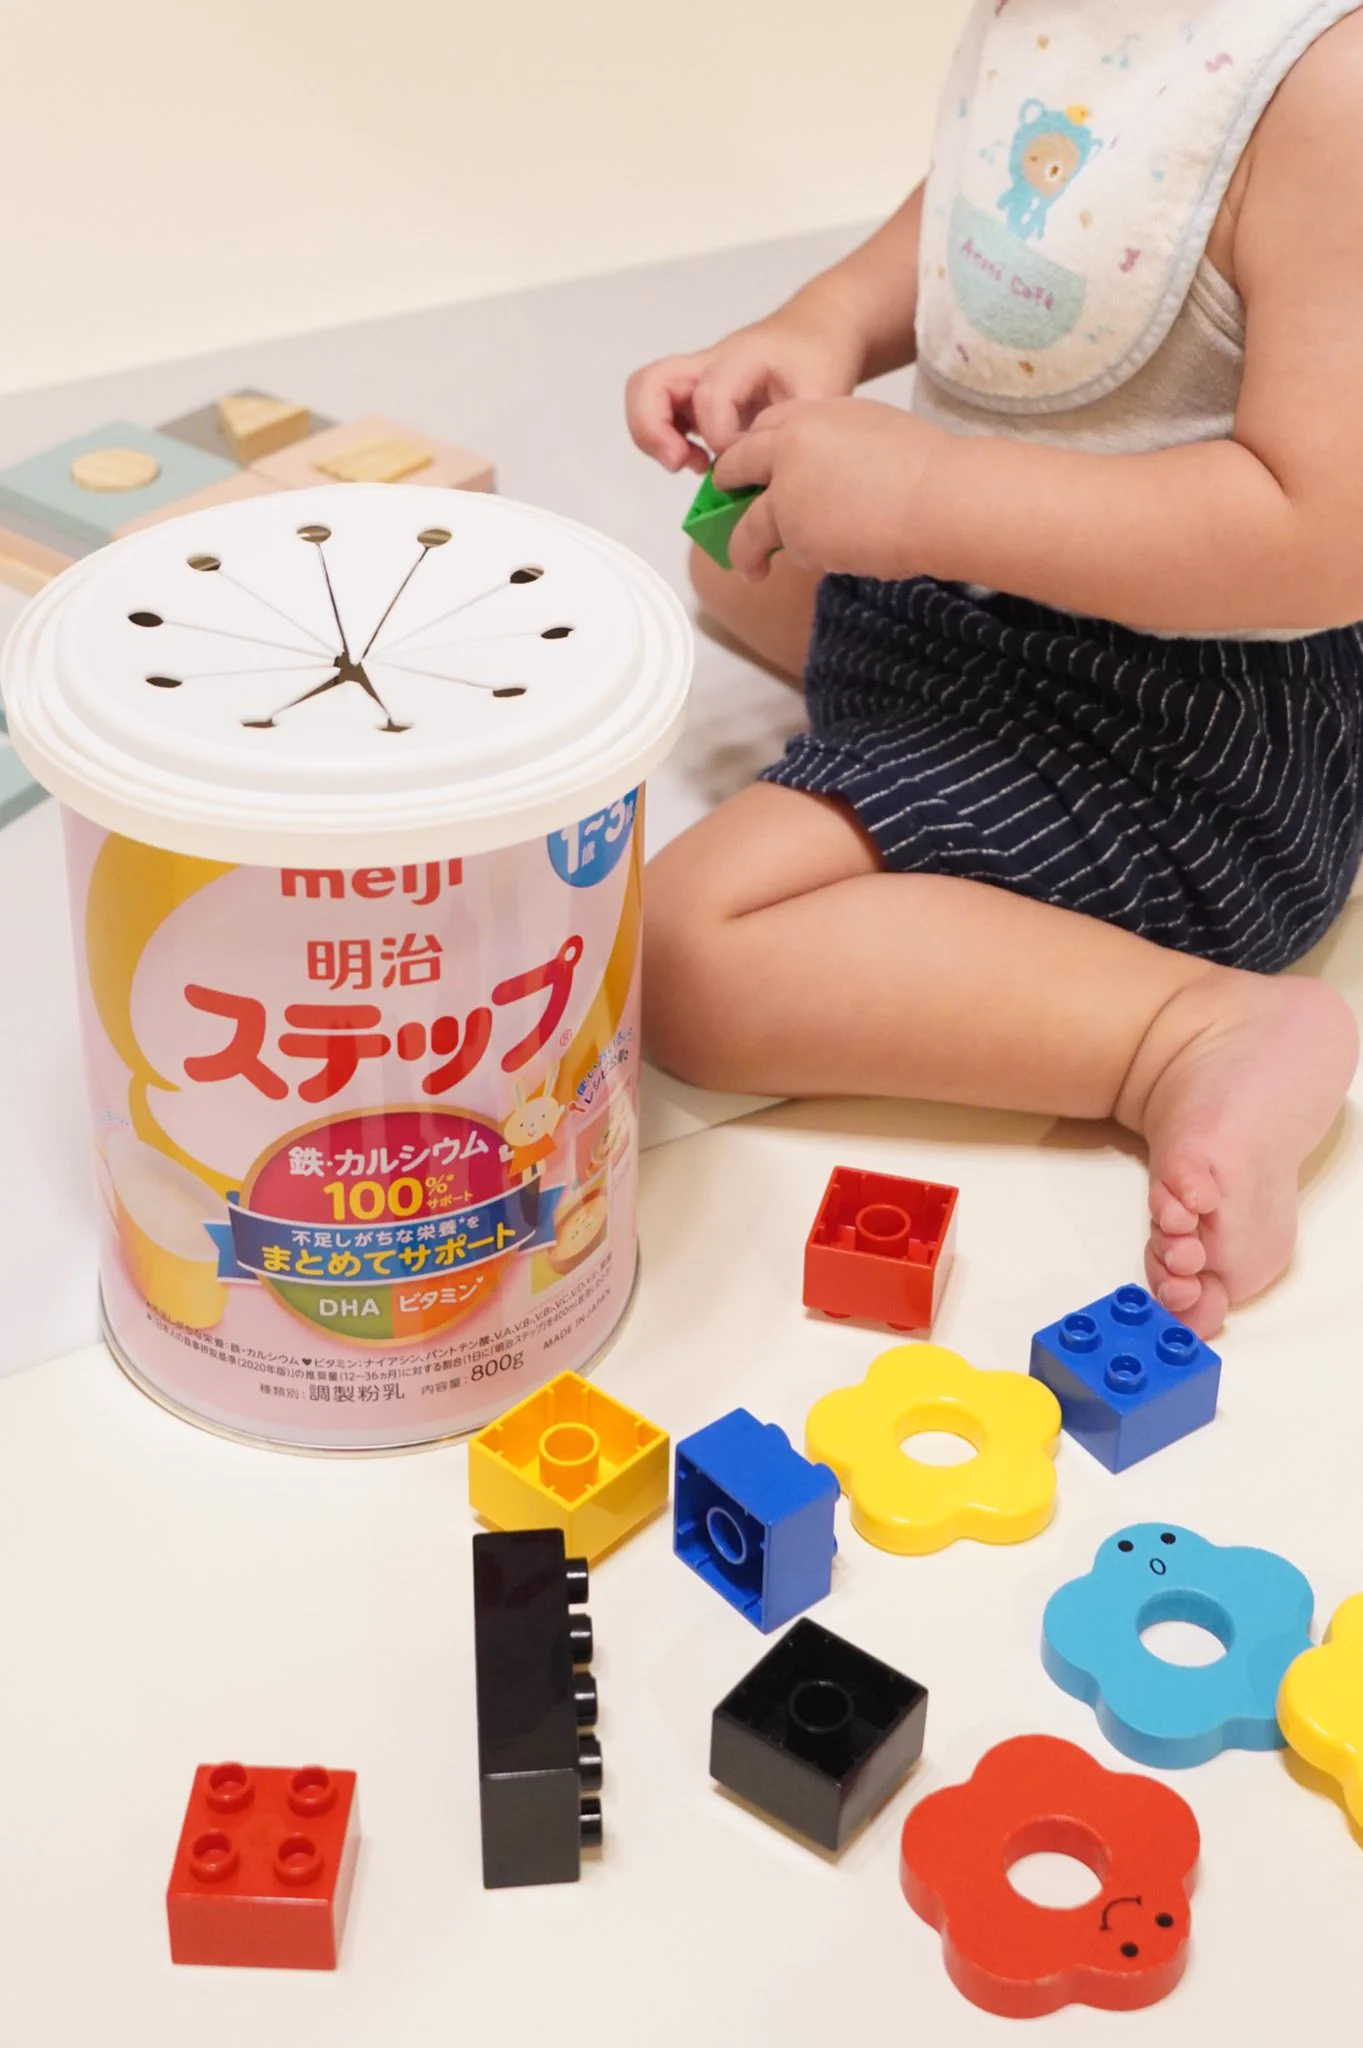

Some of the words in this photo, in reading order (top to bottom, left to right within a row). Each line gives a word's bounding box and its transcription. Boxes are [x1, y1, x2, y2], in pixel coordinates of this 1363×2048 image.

[306, 932, 442, 991] 明治
[183, 934, 584, 1104] ステップ
[288, 1130, 489, 1178] 鉄・カルシウム
[261, 1222, 517, 1277] まとめてサポート
[318, 1298, 380, 1317] DHA
[399, 1282, 478, 1313] ビタミン
[542, 1325, 572, 1350] MADE
[575, 1314, 586, 1328] IN
